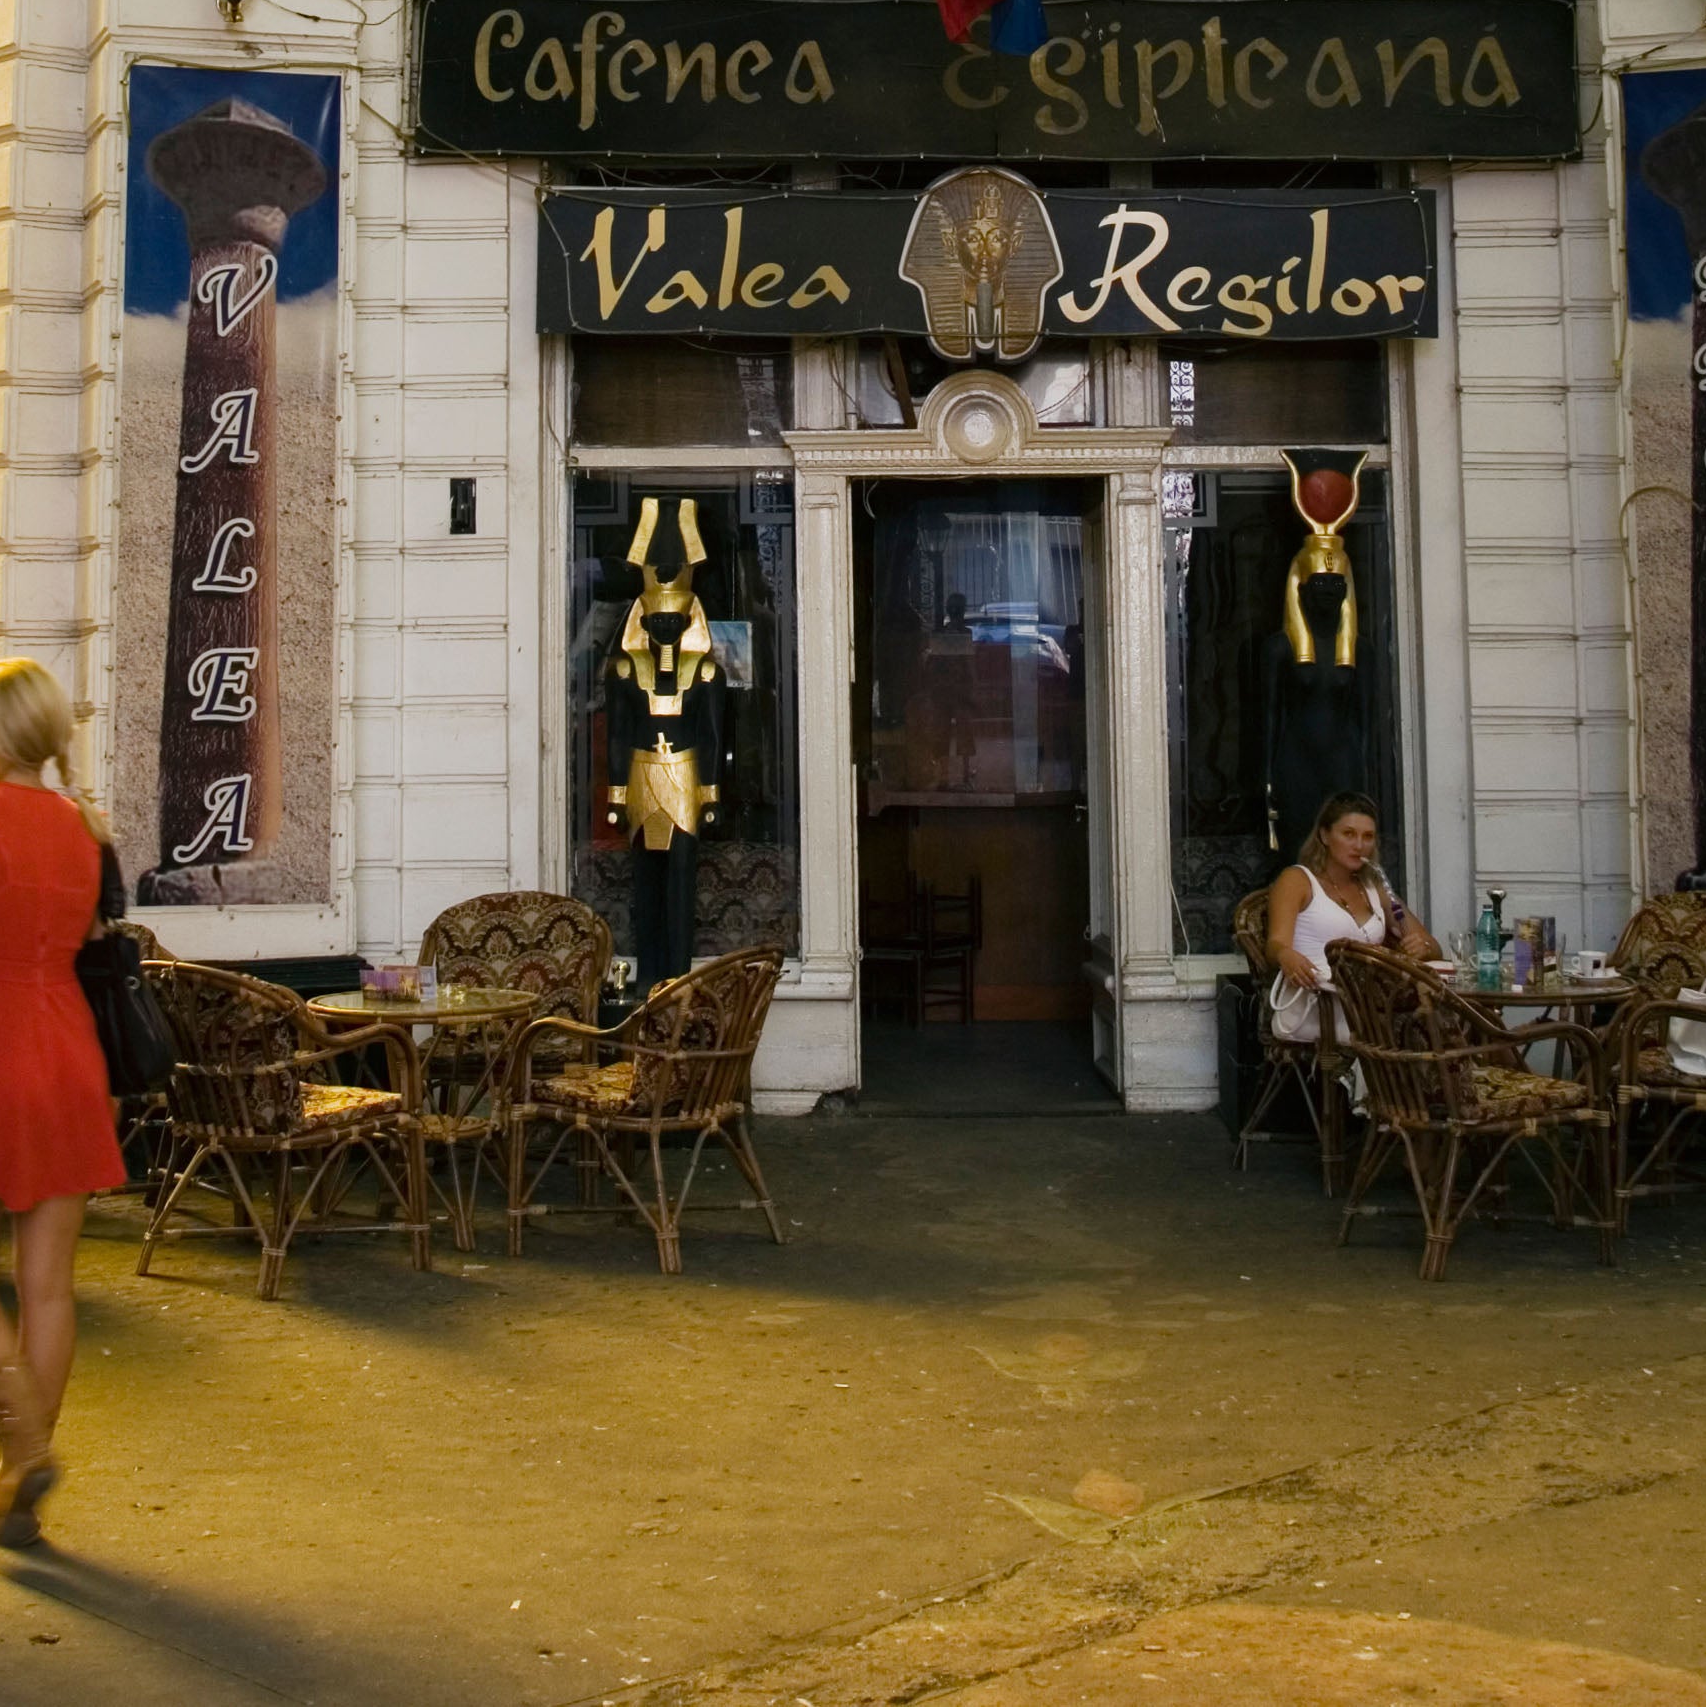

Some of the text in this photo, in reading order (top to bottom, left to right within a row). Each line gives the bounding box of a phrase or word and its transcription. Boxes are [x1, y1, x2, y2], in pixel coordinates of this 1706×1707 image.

[474, 9, 835, 131] Cafenea
[580, 203, 1425, 337] Valea Regilor
[173, 254, 279, 864] VALEA
